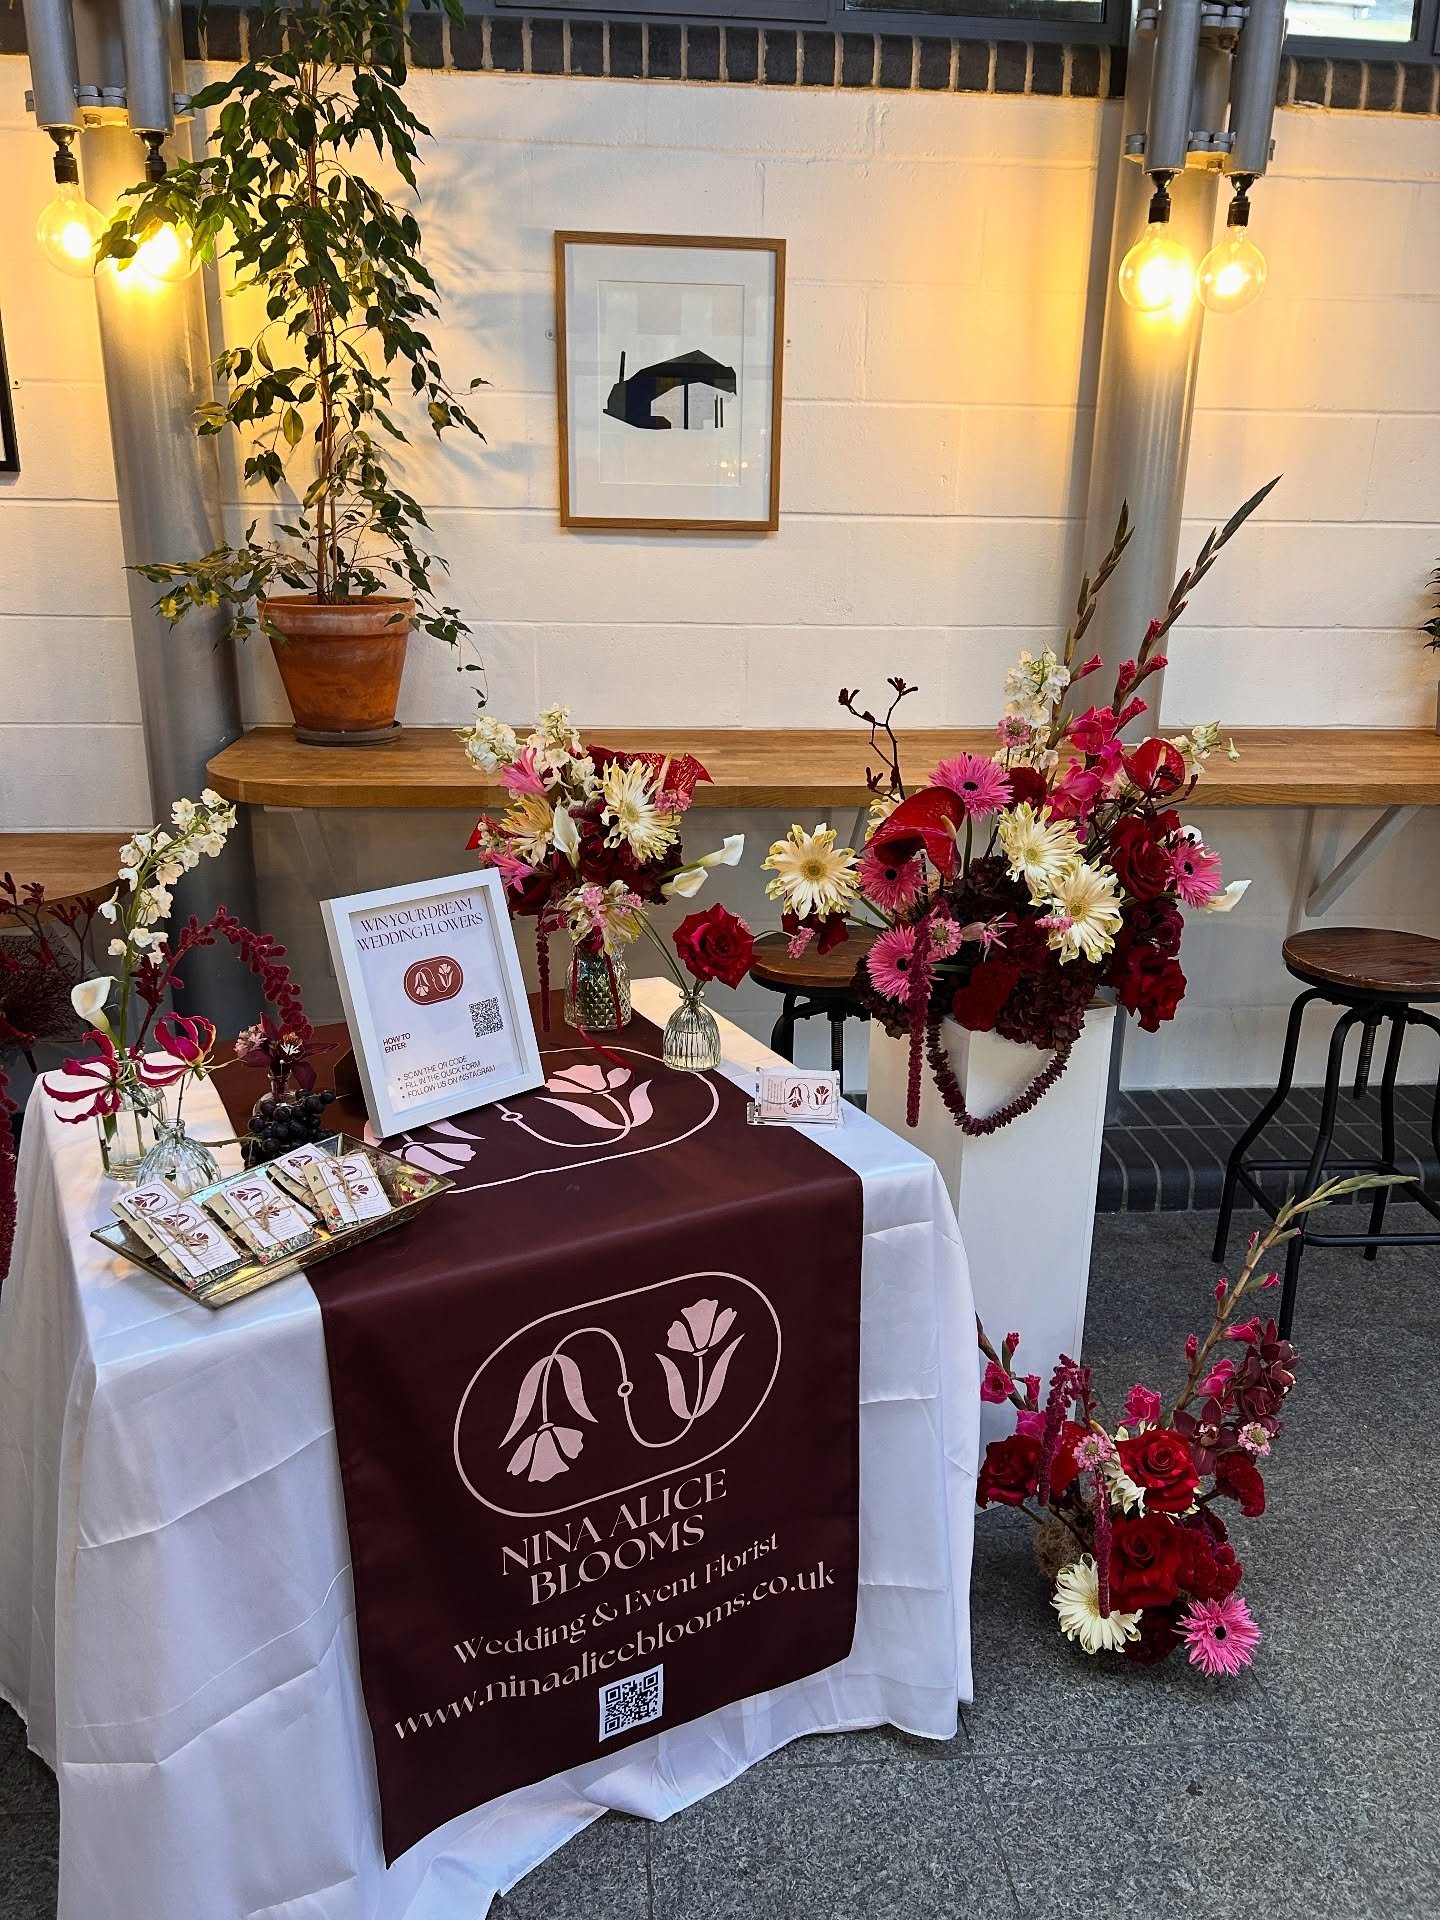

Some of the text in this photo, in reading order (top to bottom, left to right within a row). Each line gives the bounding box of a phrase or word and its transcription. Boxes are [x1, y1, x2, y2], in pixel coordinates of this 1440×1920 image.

[357, 912, 484, 951] WEDDING FLOWERS
[361, 898, 473, 932] WIN YOUR DREAM
[383, 1032, 411, 1046] HOW TO
[403, 1069, 423, 1081] SCAN
[423, 1065, 437, 1075] THE
[448, 1055, 468, 1067] CODE
[405, 1060, 481, 1089] FILL IN THE QUICK FORM
[407, 1064, 496, 1098] FOLLOW US ON INSTAGRAM
[501, 1468, 728, 1576] NINA ALICE
[529, 1514, 706, 1606] BLOOMS
[453, 1532, 780, 1665] Wedding & Event Florist
[394, 1561, 836, 1740] www.ninaaliceblooms.co.uk
